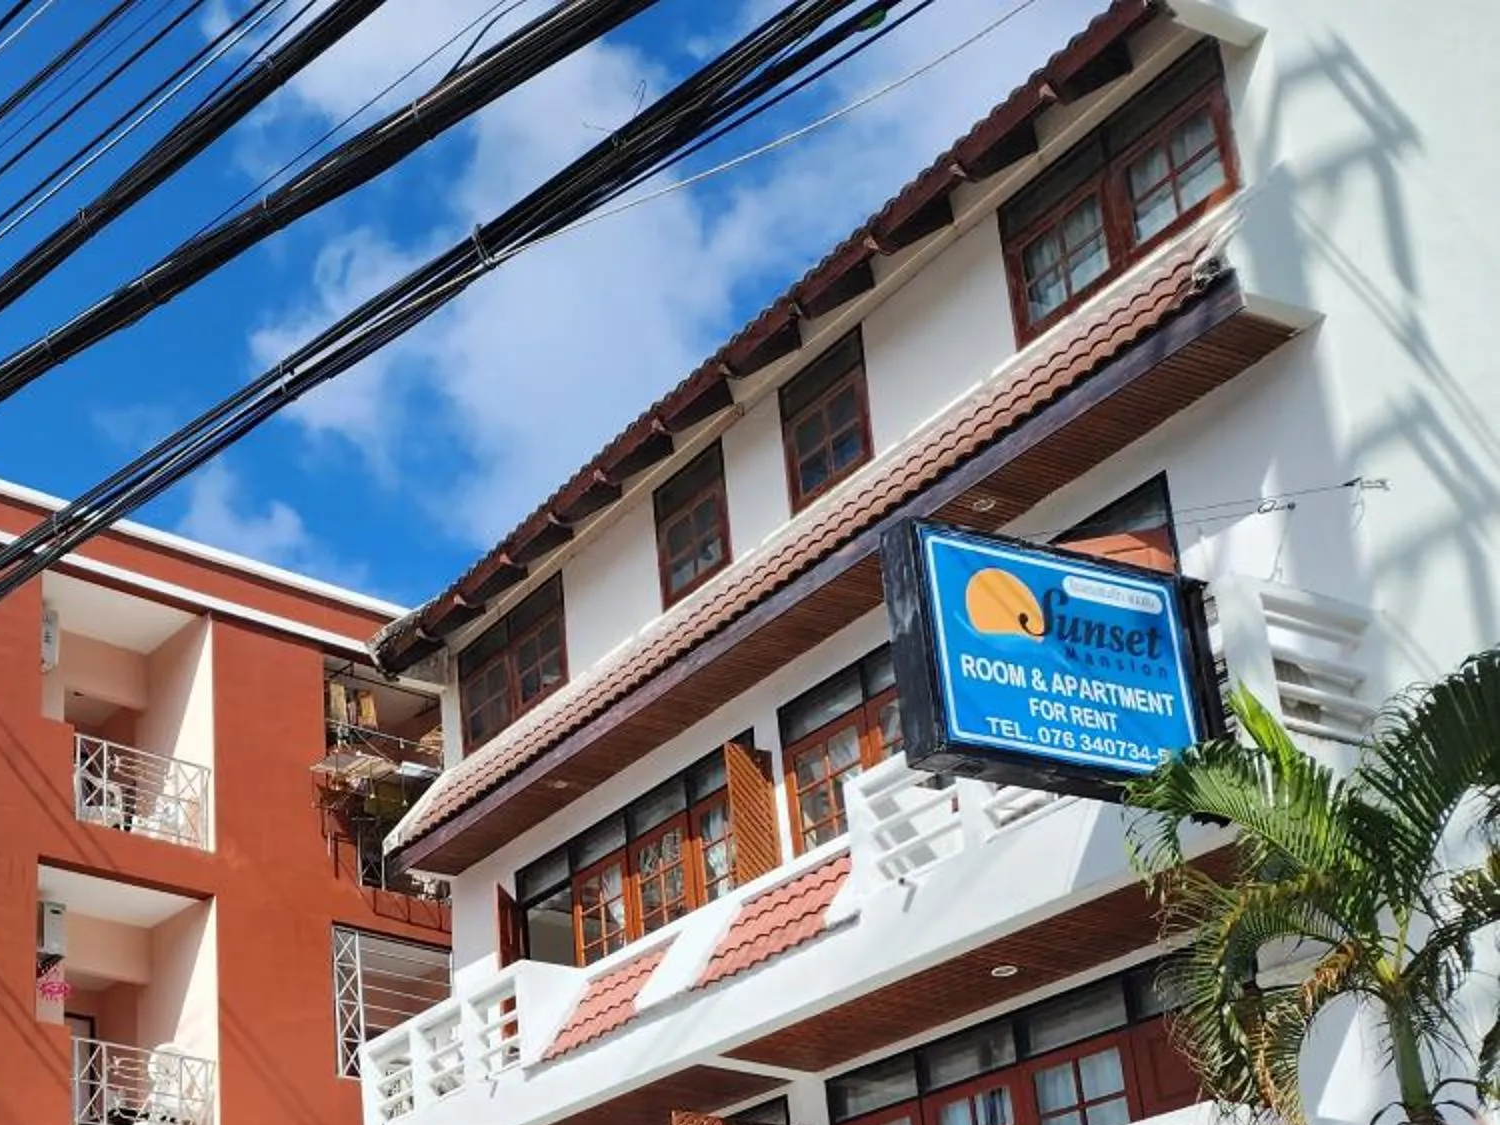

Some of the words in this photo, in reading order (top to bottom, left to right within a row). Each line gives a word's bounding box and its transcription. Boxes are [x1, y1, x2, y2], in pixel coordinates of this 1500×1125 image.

[1018, 588, 1163, 660] Sunset
[960, 653, 1026, 689] ROOM
[1031, 668, 1048, 692] &
[1051, 672, 1175, 717] APARTMENT
[985, 716, 1033, 742] TEL.
[1037, 726, 1076, 749] 076
[1028, 697, 1067, 723] FOR
[1069, 705, 1118, 733] RENT
